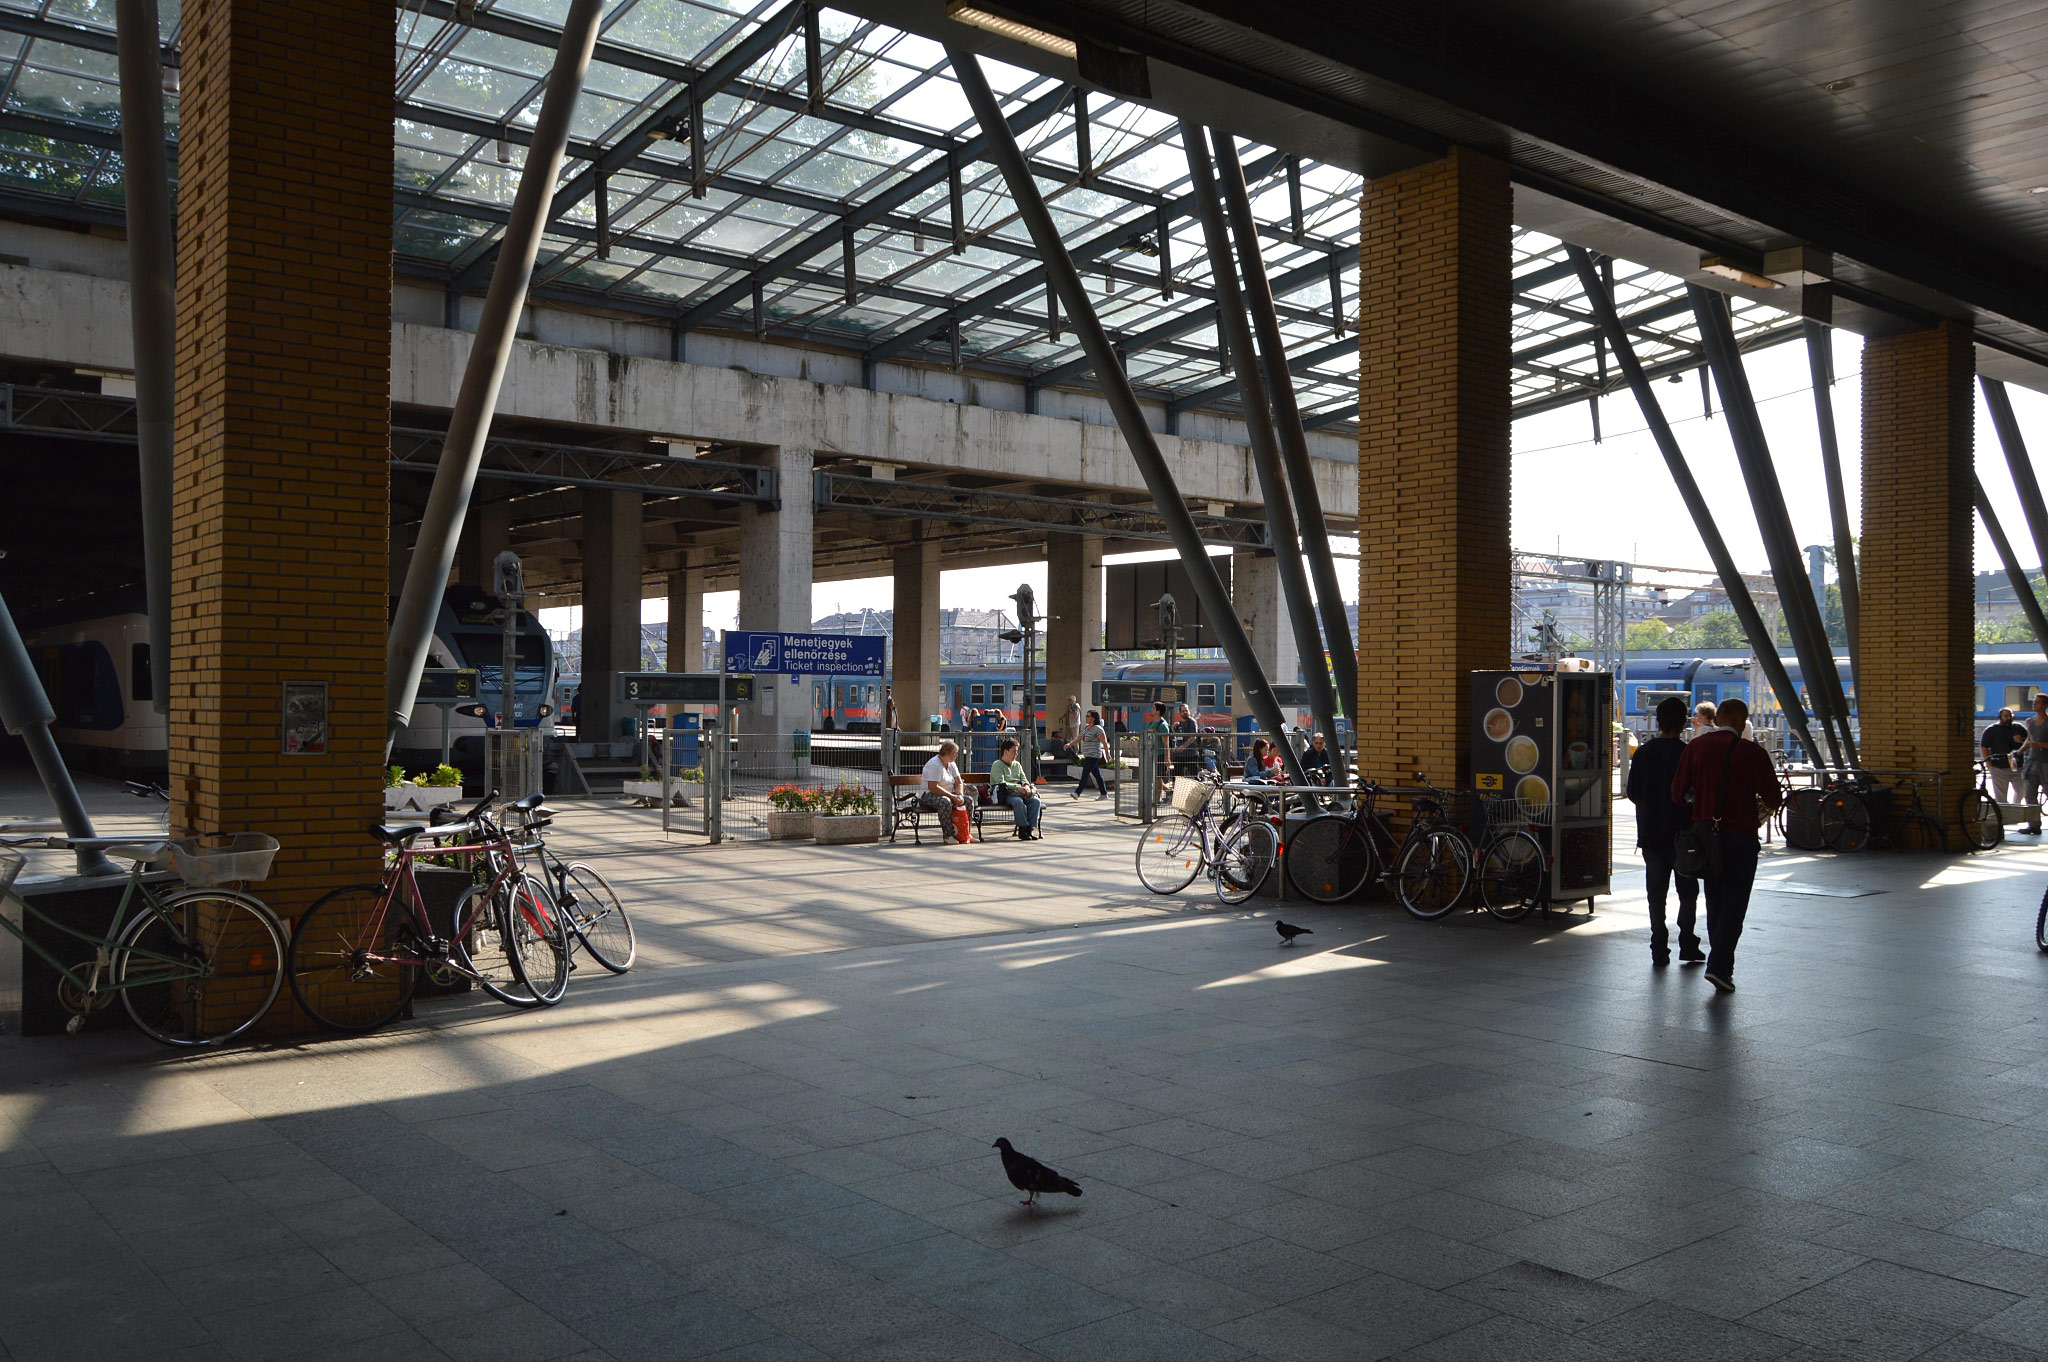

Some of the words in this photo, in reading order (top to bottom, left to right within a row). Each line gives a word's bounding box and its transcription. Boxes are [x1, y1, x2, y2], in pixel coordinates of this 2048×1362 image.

[784, 635, 853, 649] Menetjegyek
[784, 648, 847, 661] ellenőrzése
[784, 660, 813, 671] Ticket
[817, 661, 864, 673] inspection
[629, 681, 639, 696] 3
[1102, 687, 1109, 699] 4
